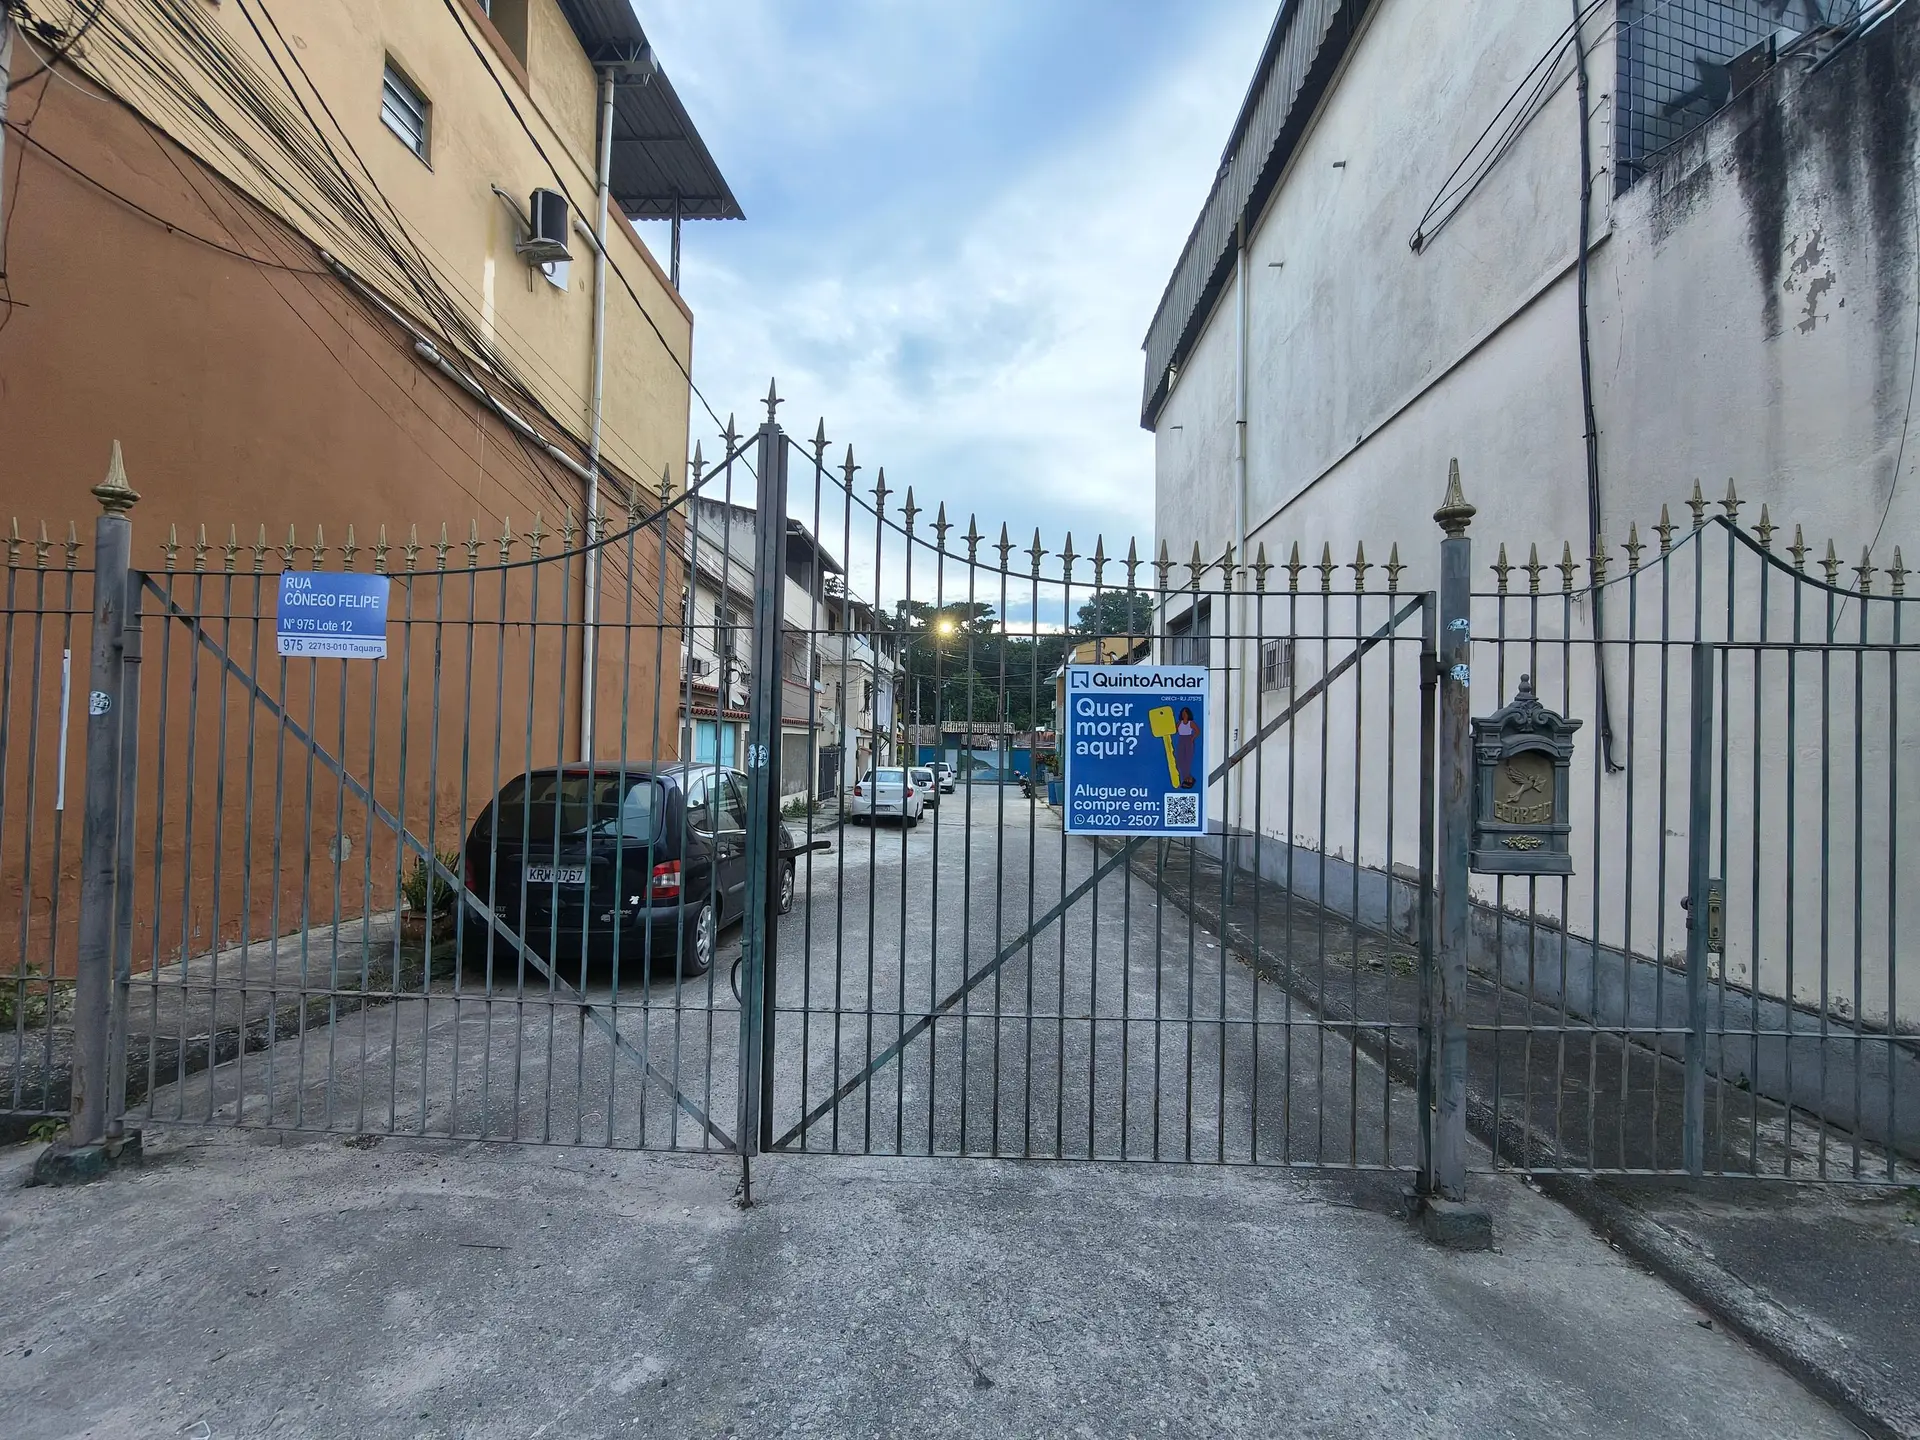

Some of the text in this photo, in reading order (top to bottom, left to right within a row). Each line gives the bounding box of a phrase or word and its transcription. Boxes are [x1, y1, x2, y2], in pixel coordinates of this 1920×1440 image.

[286, 577, 312, 589] RUA
[284, 590, 380, 608] CÔNEGO FELIPE
[297, 619, 315, 630] 975
[317, 620, 338, 631] Lote
[340, 621, 352, 631] 12
[283, 639, 382, 653] 975 22713-010 Taquara
[1092, 672, 1204, 688] QuintoAndar
[1076, 698, 1133, 718] Quer
[1076, 721, 1144, 736] morar
[1076, 737, 1138, 759] aqui?
[1074, 784, 1148, 799] Alugue ou
[1074, 800, 1160, 813] compre em:
[1086, 815, 1159, 827] 4020-2507
